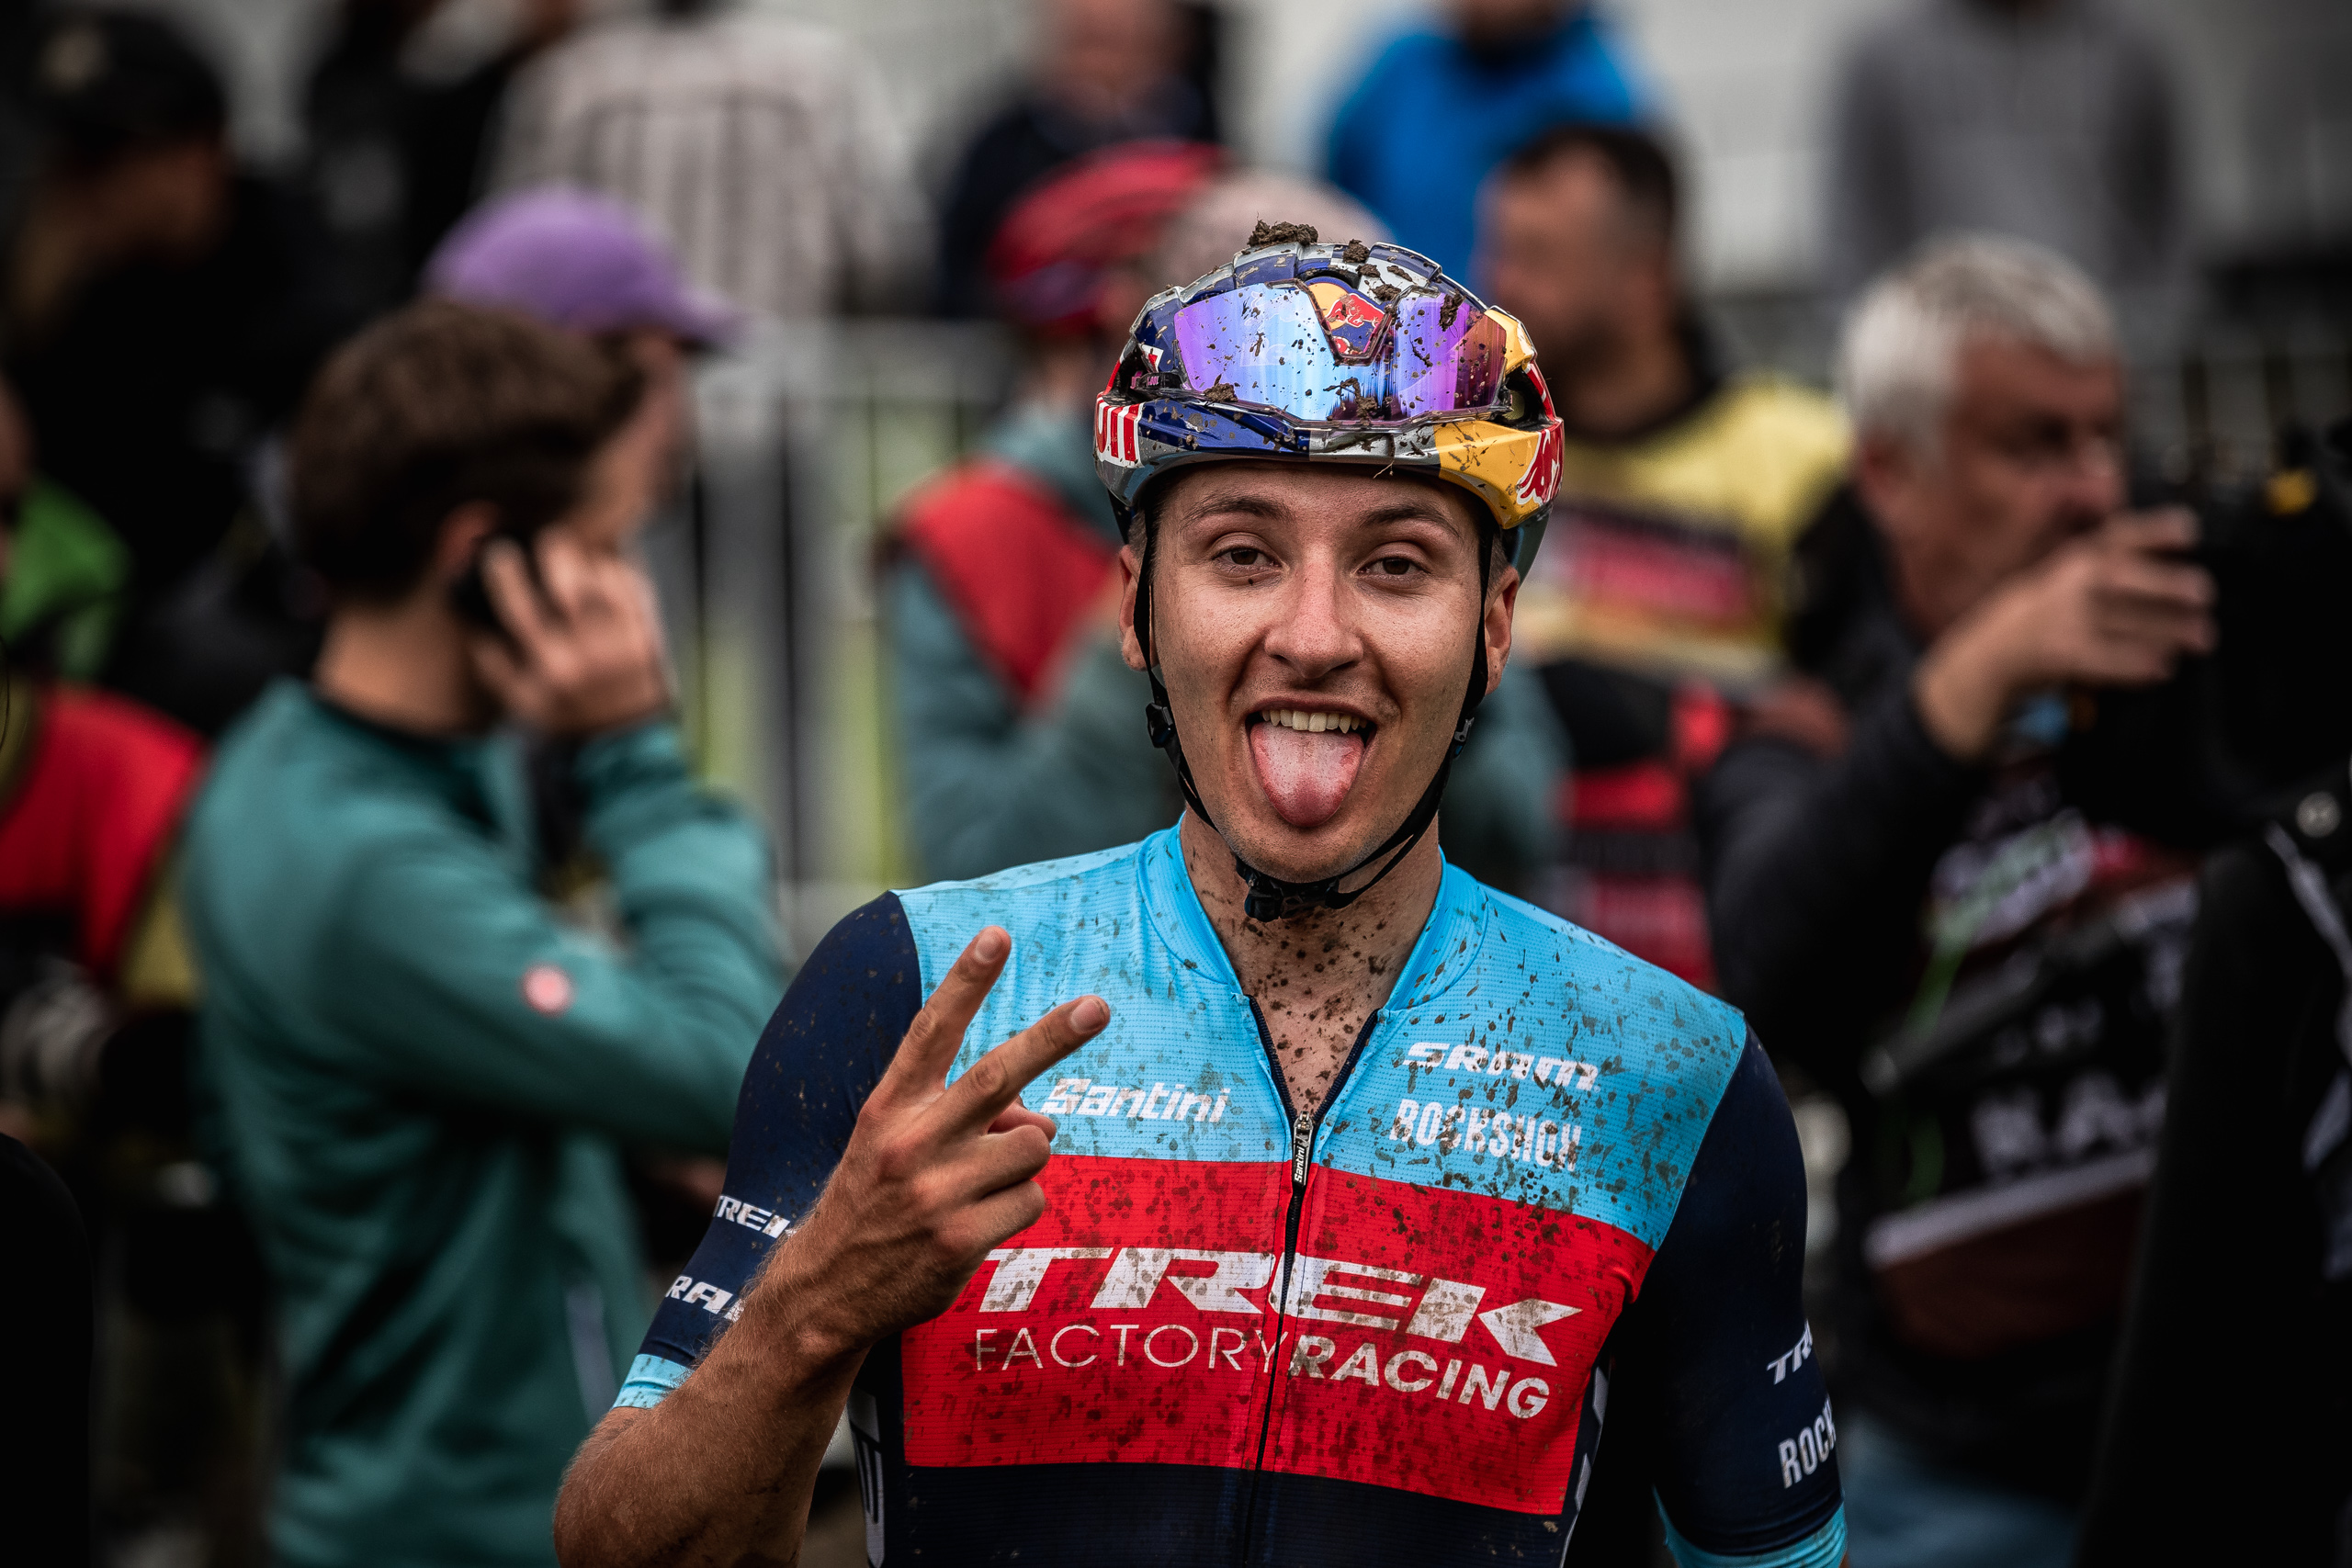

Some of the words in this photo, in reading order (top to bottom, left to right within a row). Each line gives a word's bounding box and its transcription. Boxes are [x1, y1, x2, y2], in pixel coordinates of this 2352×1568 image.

[1402, 1042, 1599, 1091] SRAM
[1039, 1077, 1231, 1122] Santini
[1293, 1145, 1306, 1183] Santini
[1388, 1098, 1582, 1172] ROCKSHOX
[712, 1194, 797, 1239] RE
[978, 1247, 1584, 1368] TREK
[976, 1323, 1289, 1374] FACTORY
[1287, 1334, 1551, 1419] RACING
[1777, 1392, 1837, 1489] ROCK
